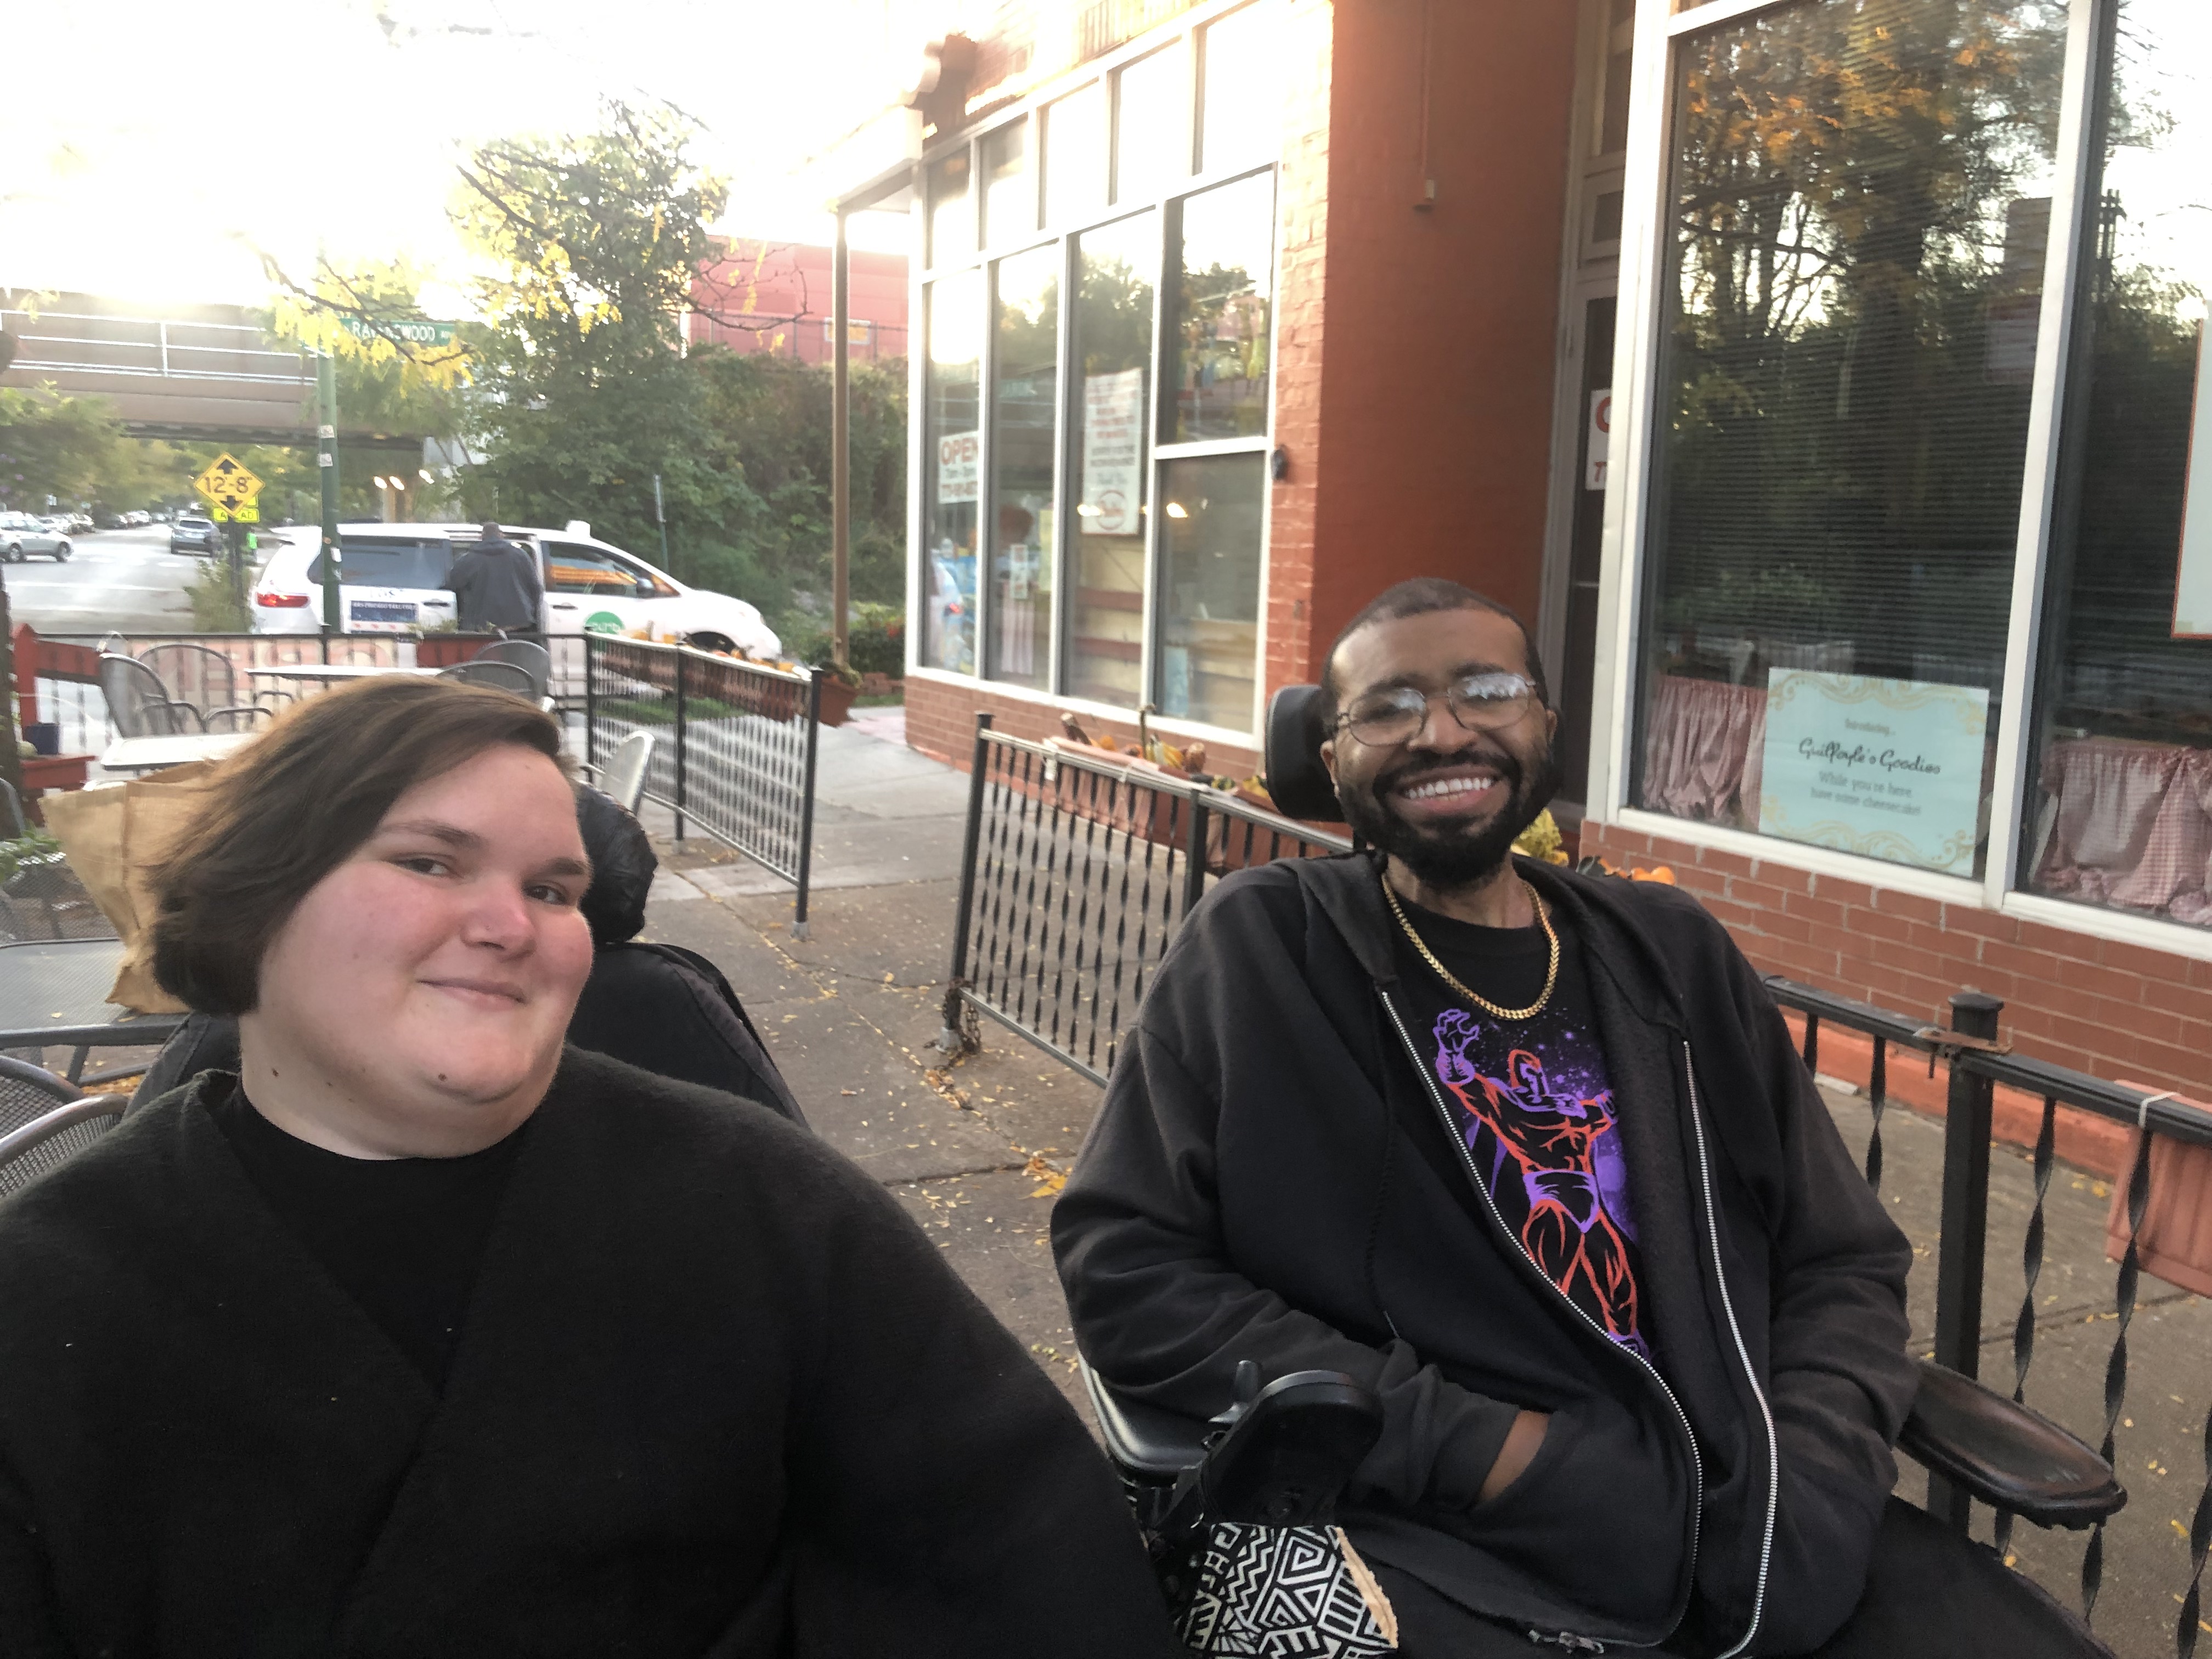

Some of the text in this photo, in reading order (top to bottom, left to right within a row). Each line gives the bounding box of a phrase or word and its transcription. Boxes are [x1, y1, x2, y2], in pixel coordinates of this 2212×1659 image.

[351, 321, 436, 342] RAVNSWOOD
[221, 511, 254, 520] AAD
[1879, 748, 1941, 774] Goodies
[1819, 770, 1848, 786] While
